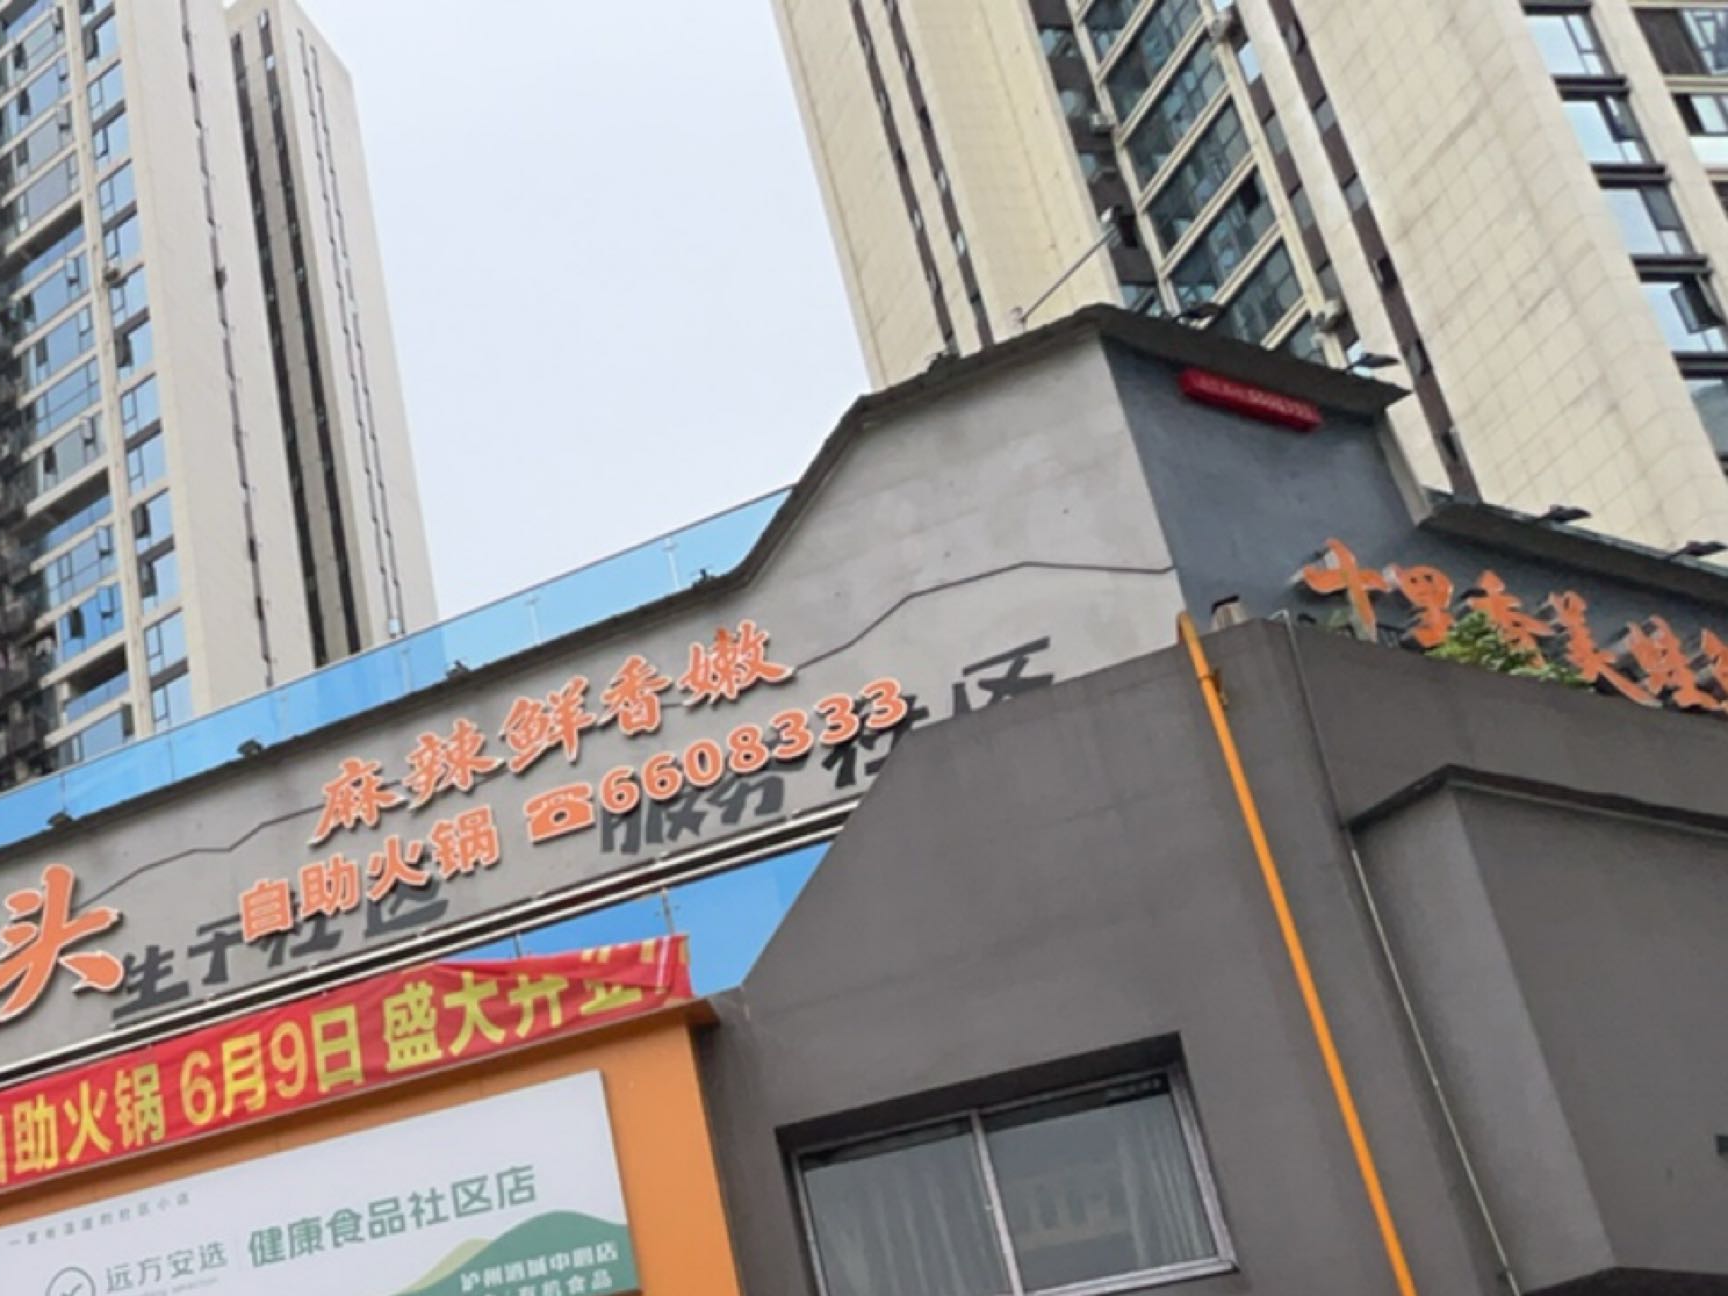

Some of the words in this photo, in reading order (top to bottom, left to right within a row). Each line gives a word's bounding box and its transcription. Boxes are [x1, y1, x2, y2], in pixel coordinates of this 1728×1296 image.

[1290, 536, 1728, 715] 十里香美蛙
[239, 806, 501, 942] 自助火锅
[599, 677, 908, 813] 6608333
[313, 619, 794, 845] 麻辣鲜香嫩
[180, 1005, 364, 1128] 6月9日
[106, 1241, 228, 1293] 远方安选
[249, 1164, 539, 1270] 健康食品社区店
